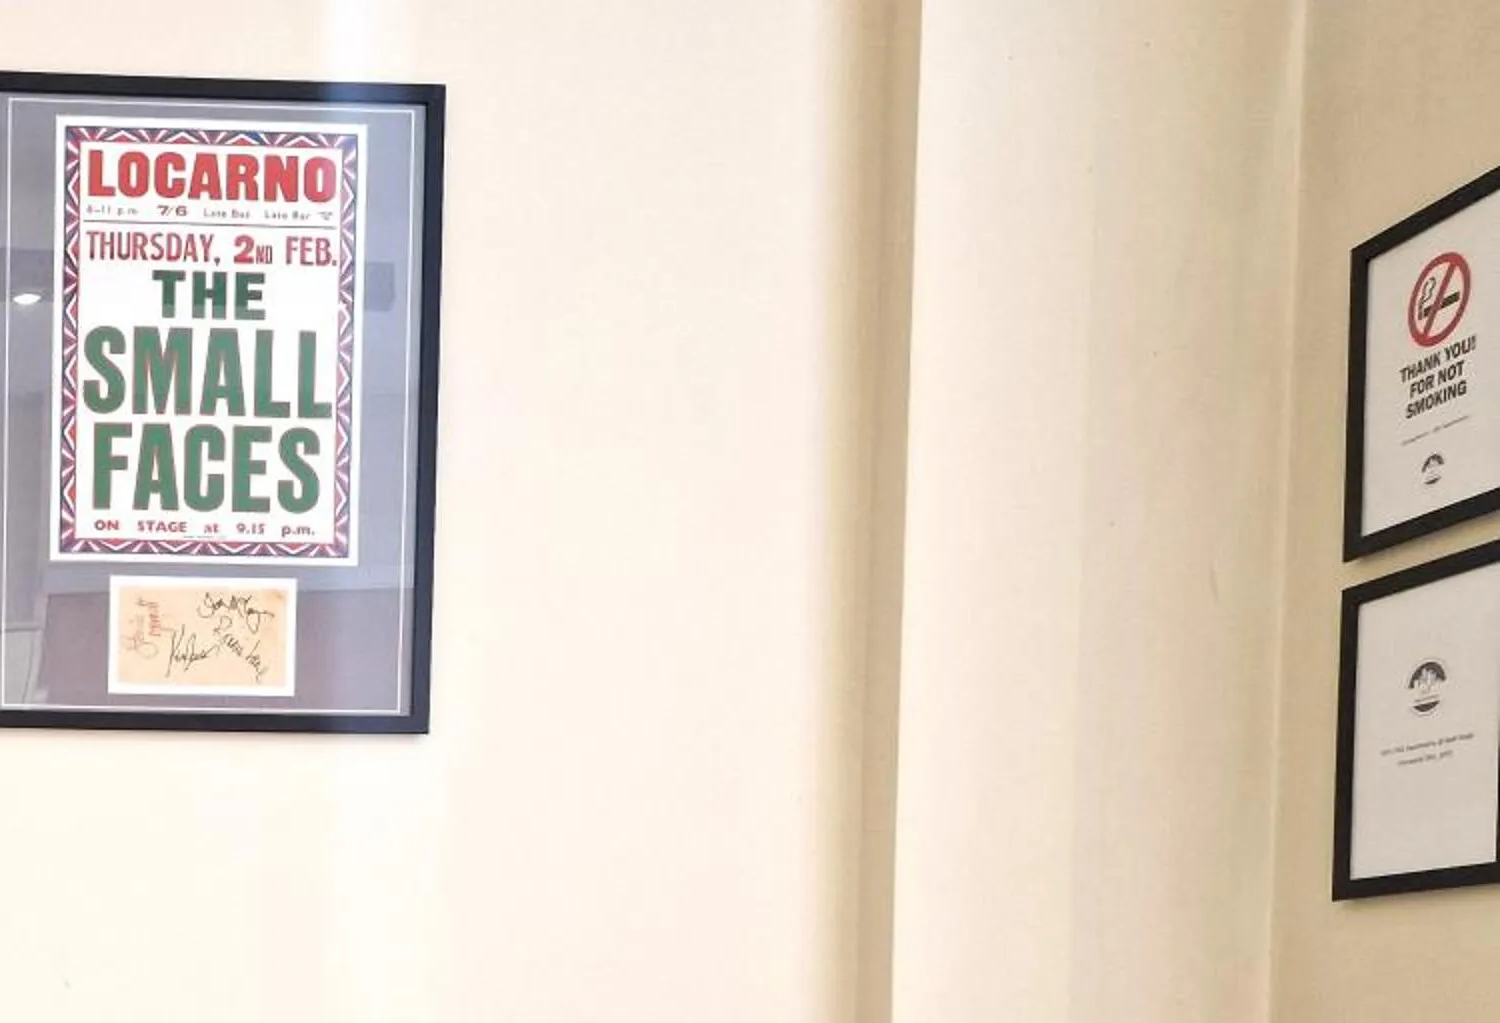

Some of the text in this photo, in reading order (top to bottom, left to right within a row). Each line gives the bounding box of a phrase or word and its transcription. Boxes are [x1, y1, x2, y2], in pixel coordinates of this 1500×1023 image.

[88, 150, 337, 203] LOCARNO
[156, 204, 188, 217] 7/6
[86, 231, 337, 266] THURSDAY, 2ND FEB.
[152, 269, 266, 320] THE
[83, 325, 333, 418] SMALL
[1400, 335, 1476, 382] THANK YOU!
[1410, 360, 1464, 398] FOR NOT
[1406, 379, 1467, 418] SMOKING
[92, 422, 320, 514] FACES
[94, 519, 315, 537] ON STAGE at 9.15 p.m.
